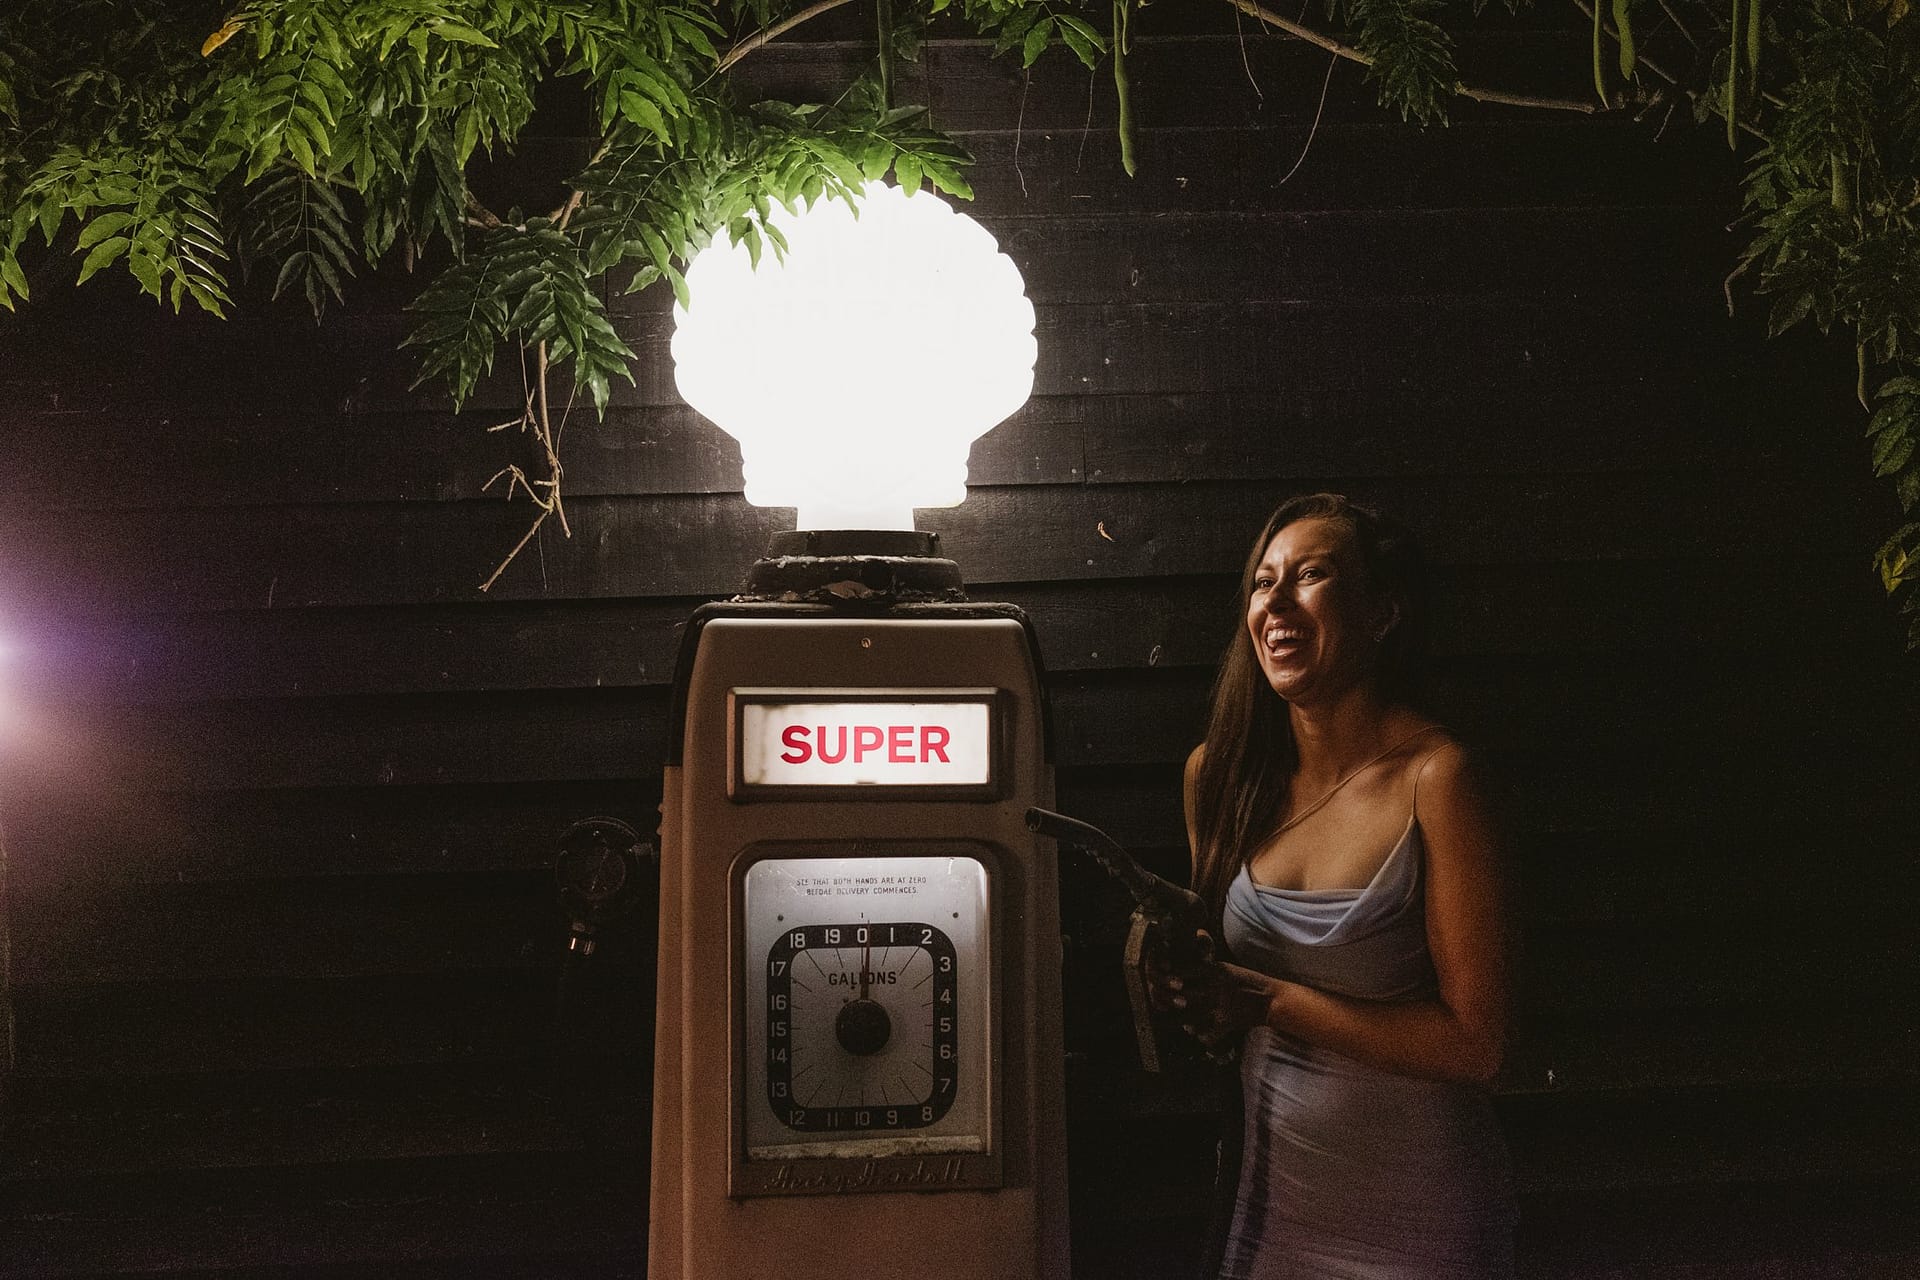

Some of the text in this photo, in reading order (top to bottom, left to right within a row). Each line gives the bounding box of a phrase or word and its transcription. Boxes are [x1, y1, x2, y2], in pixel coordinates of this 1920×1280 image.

[780, 725, 951, 764] SUPER
[813, 878, 829, 886] THAT
[855, 877, 878, 885] HANDS
[881, 876, 894, 884] ARE
[898, 876, 905, 884] AT
[908, 876, 926, 884] ZERO
[790, 933, 806, 949] 18
[825, 928, 841, 944] 19
[856, 928, 868, 943] 0
[921, 929, 933, 944] 2
[770, 961, 786, 976] 17
[939, 956, 951, 972] 3
[771, 994, 787, 1010] 16
[939, 988, 951, 1004] 4
[771, 1022, 787, 1038] 15
[939, 1017, 951, 1032] 5
[771, 1048, 787, 1063] 14
[939, 1044, 951, 1059] 6
[771, 1082, 787, 1098] 13
[939, 1078, 951, 1093] 7
[789, 1106, 933, 1127] 12 11 10 9 8
